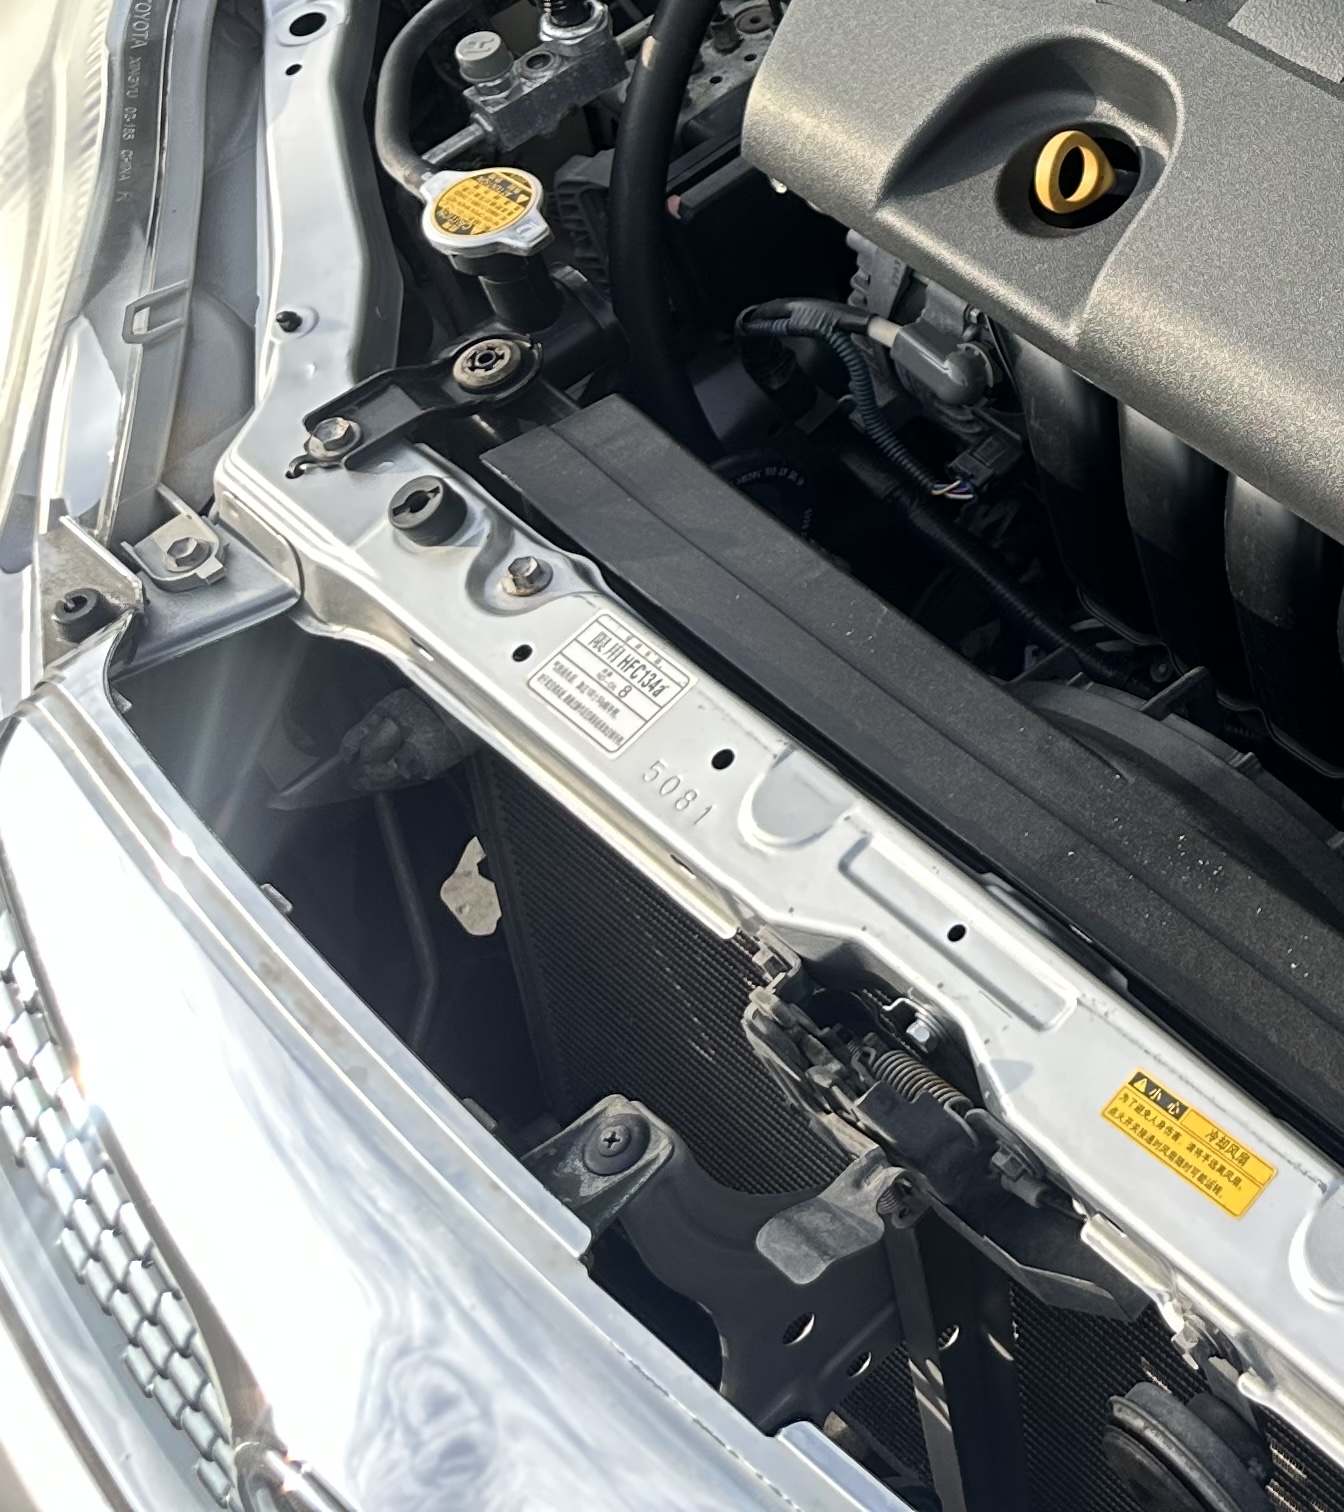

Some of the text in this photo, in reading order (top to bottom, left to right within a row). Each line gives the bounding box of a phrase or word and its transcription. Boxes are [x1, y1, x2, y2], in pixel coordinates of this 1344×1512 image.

[618, 685, 632, 699] 8
[642, 759, 714, 826] 5081
[1148, 1087, 1181, 1116] 小心
[1204, 1129, 1251, 1168] 冷却风扇
